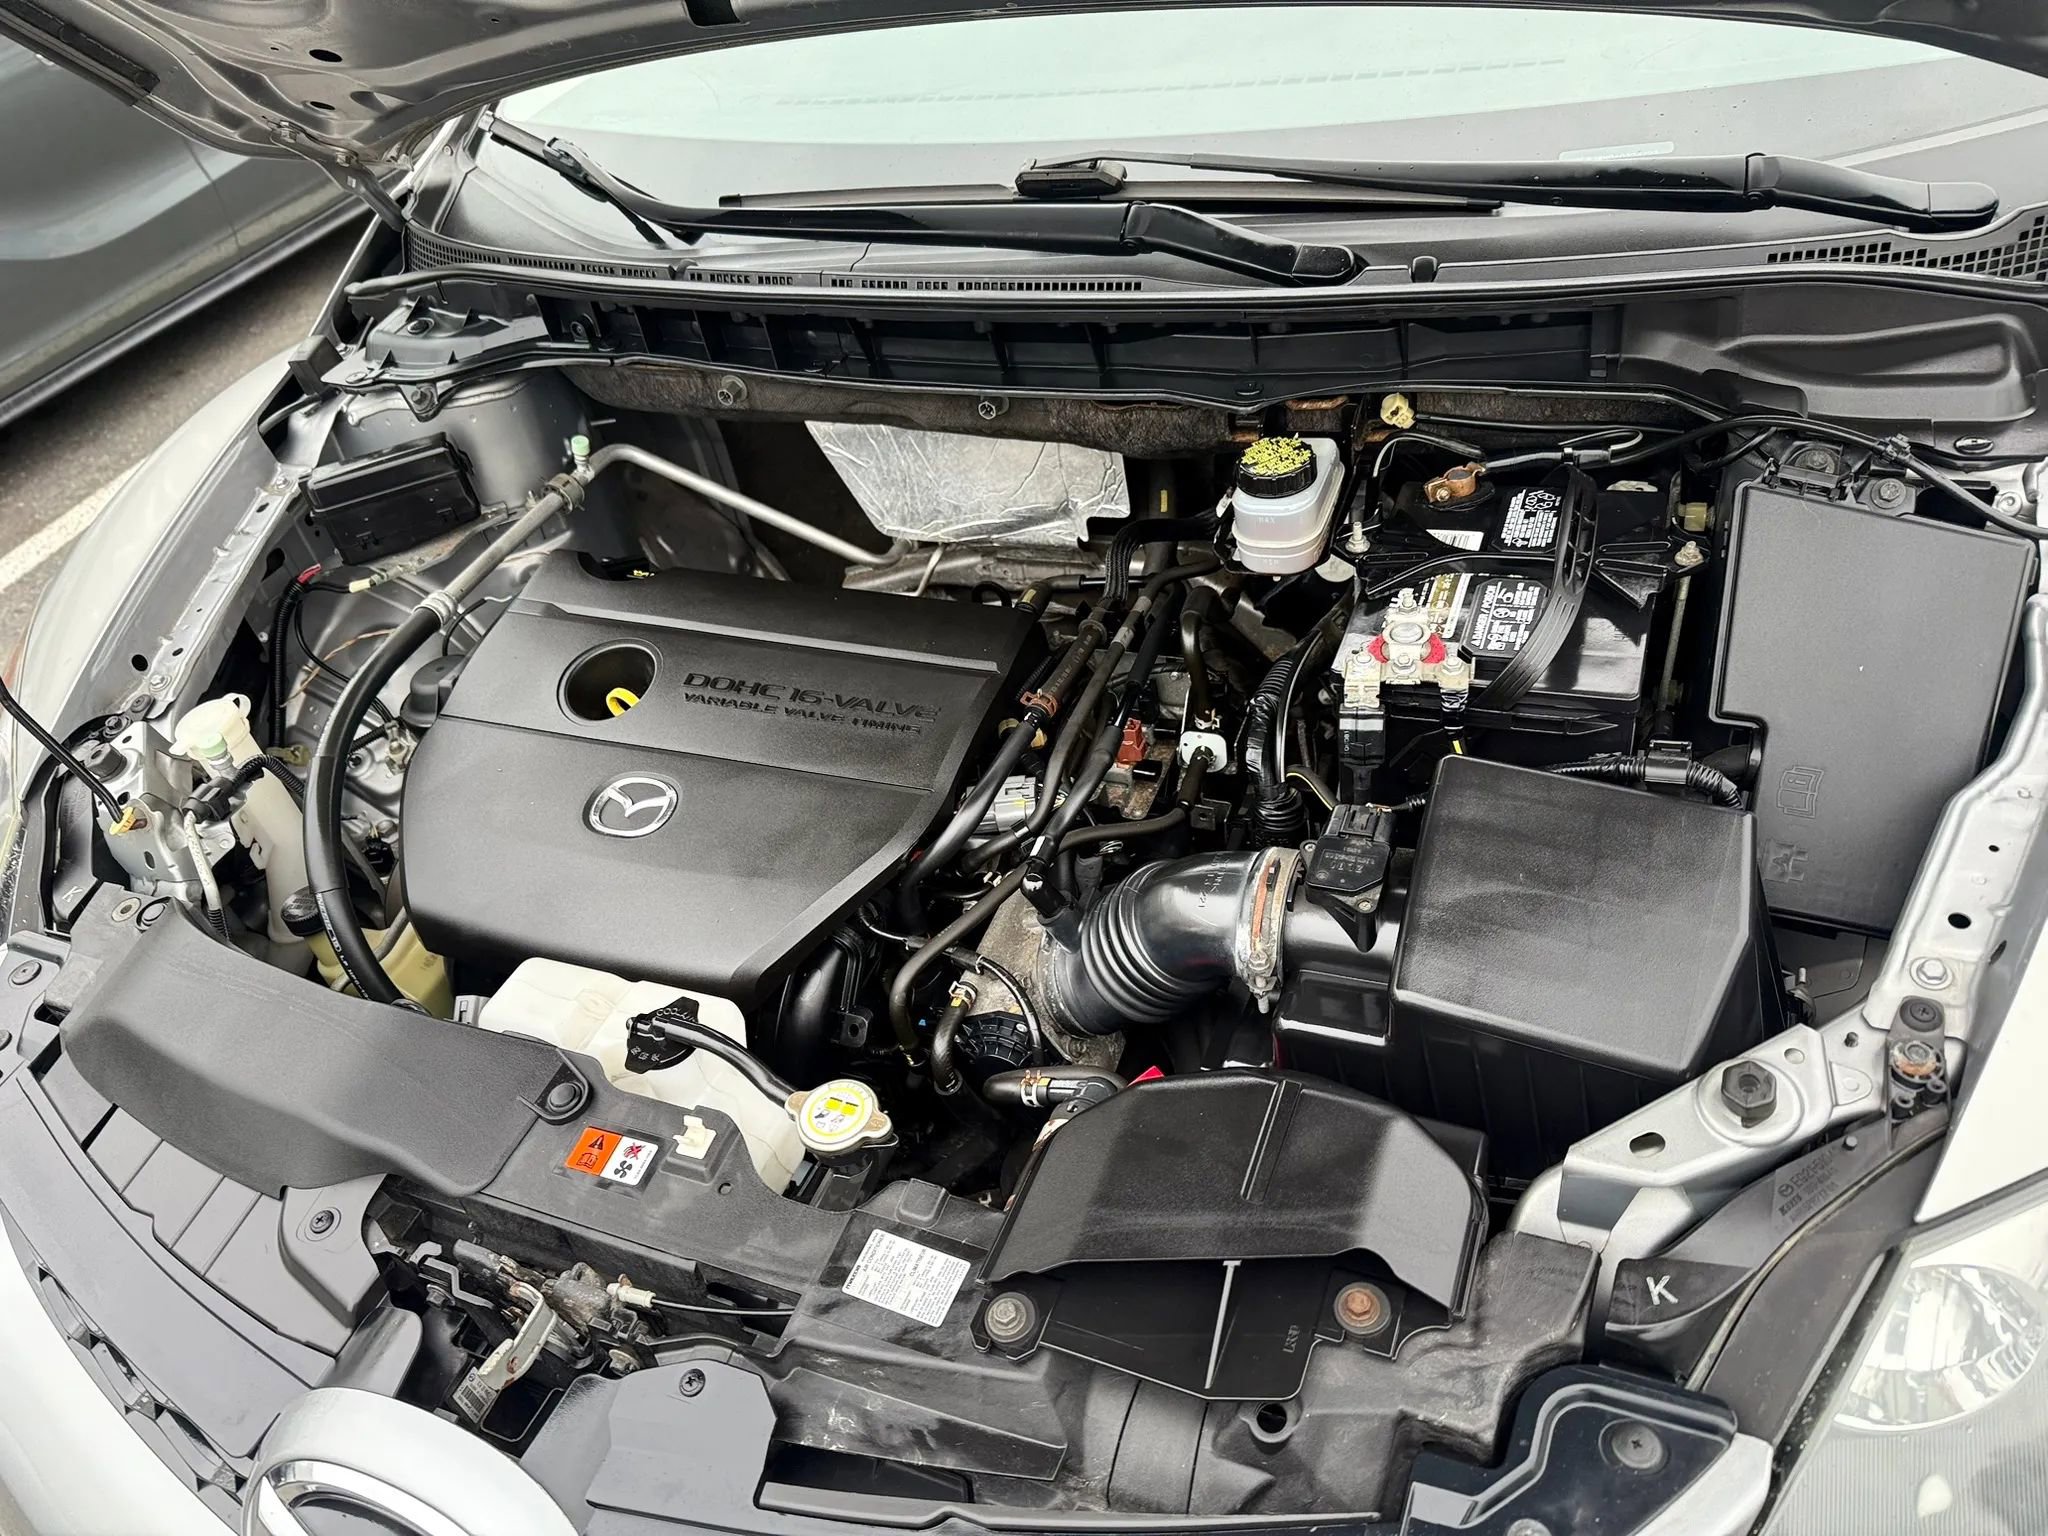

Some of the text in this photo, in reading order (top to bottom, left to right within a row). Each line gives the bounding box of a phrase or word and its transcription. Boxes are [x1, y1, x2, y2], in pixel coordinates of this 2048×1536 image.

[1472, 612, 1488, 639] DANGER
[1481, 583, 1496, 608] POISON
[683, 672, 941, 723] DOHC 16-VALVE
[684, 692, 777, 715] VARIABLE
[784, 706, 846, 724] VALVE
[1645, 1274, 1679, 1306] K
